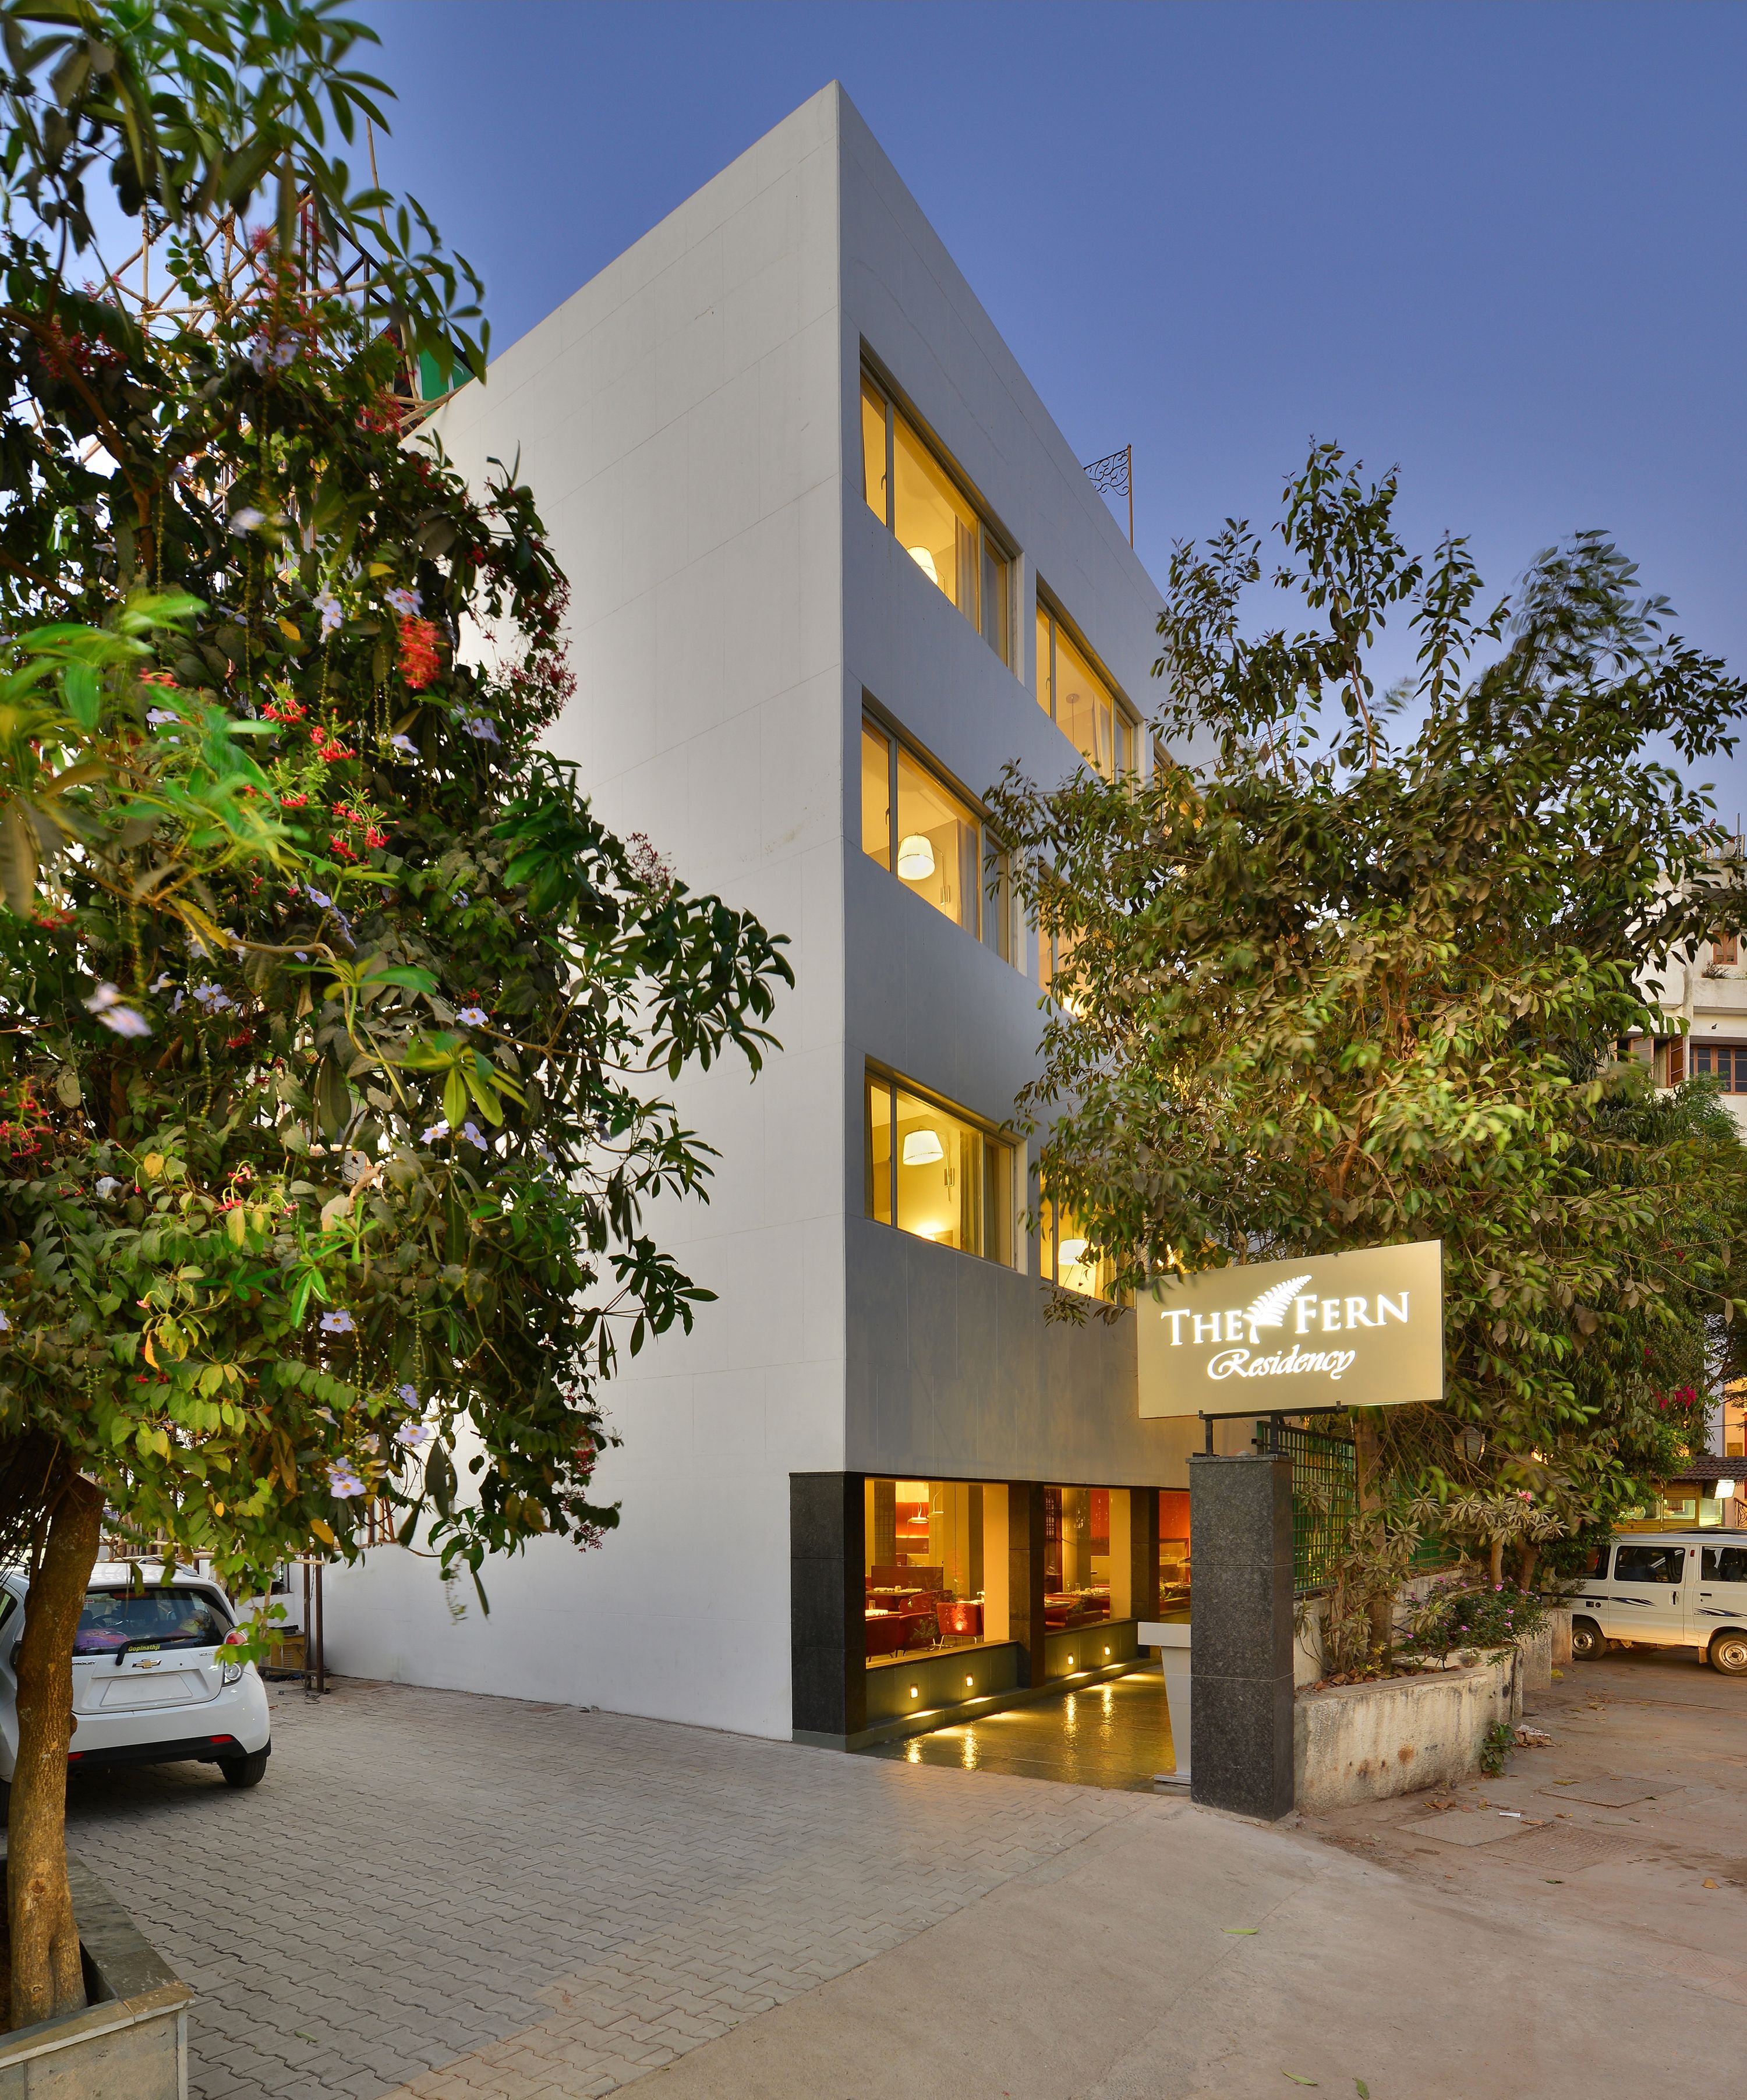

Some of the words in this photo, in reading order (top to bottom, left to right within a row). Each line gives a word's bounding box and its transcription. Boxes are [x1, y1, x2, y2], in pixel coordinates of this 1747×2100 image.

[1161, 1309, 1244, 1346] THE
[1294, 1291, 1410, 1334] FERN
[1207, 1344, 1356, 1380] Residency
